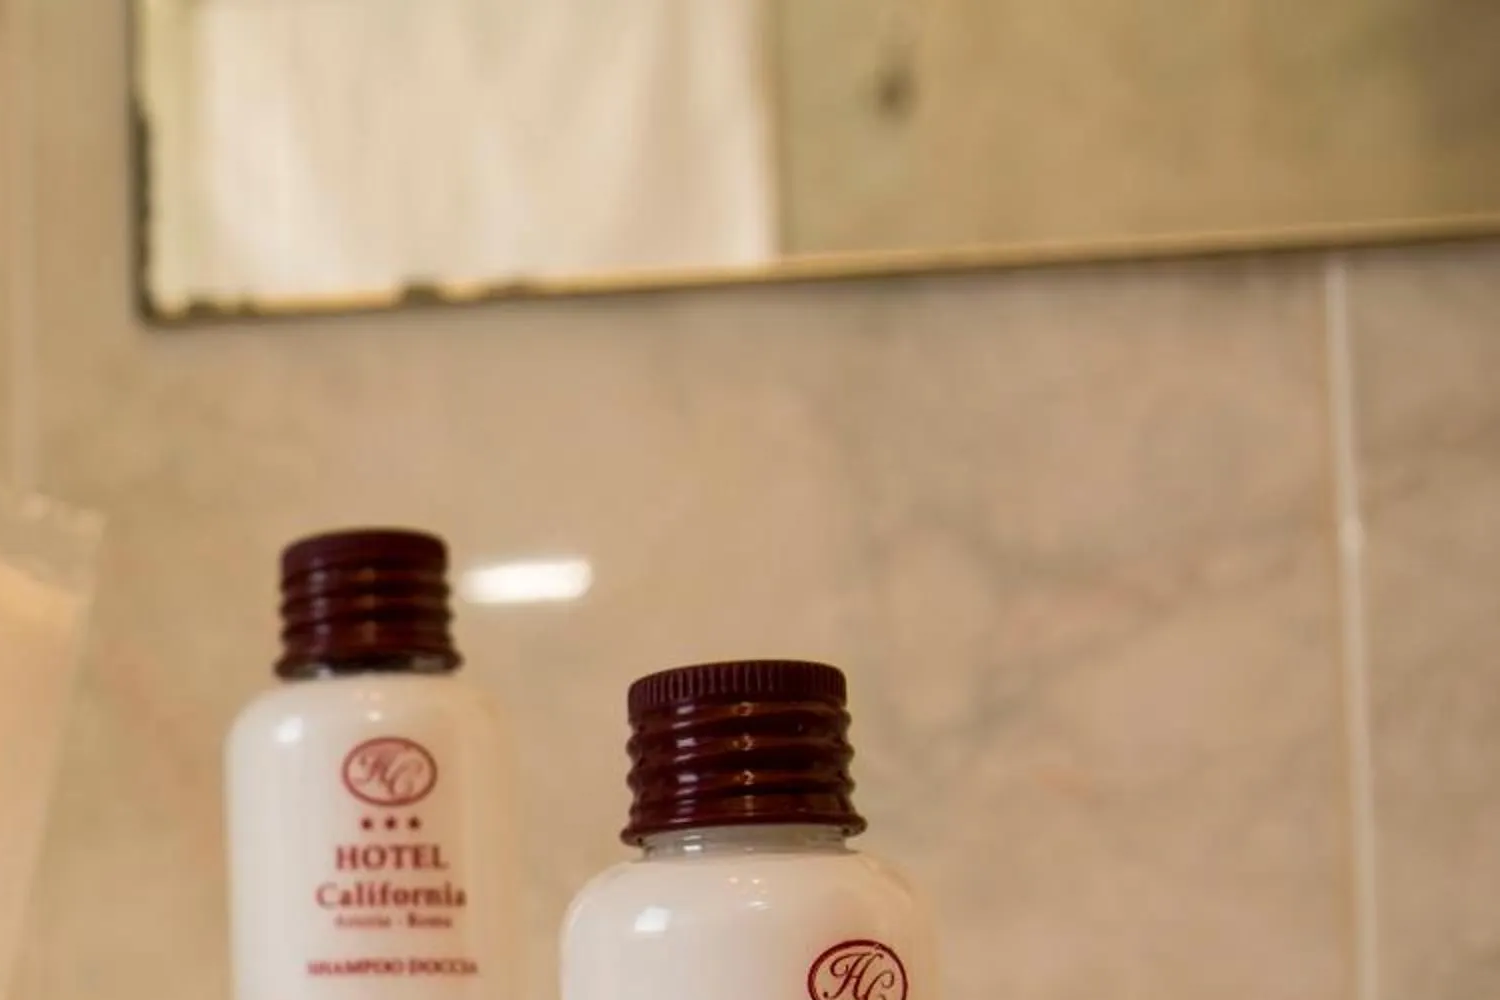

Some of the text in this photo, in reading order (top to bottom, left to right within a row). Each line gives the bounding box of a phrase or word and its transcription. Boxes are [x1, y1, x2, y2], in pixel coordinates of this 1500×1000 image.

[335, 845, 448, 870] HOTEL
[315, 882, 467, 909] California
[307, 959, 403, 975] SHAMPOO
